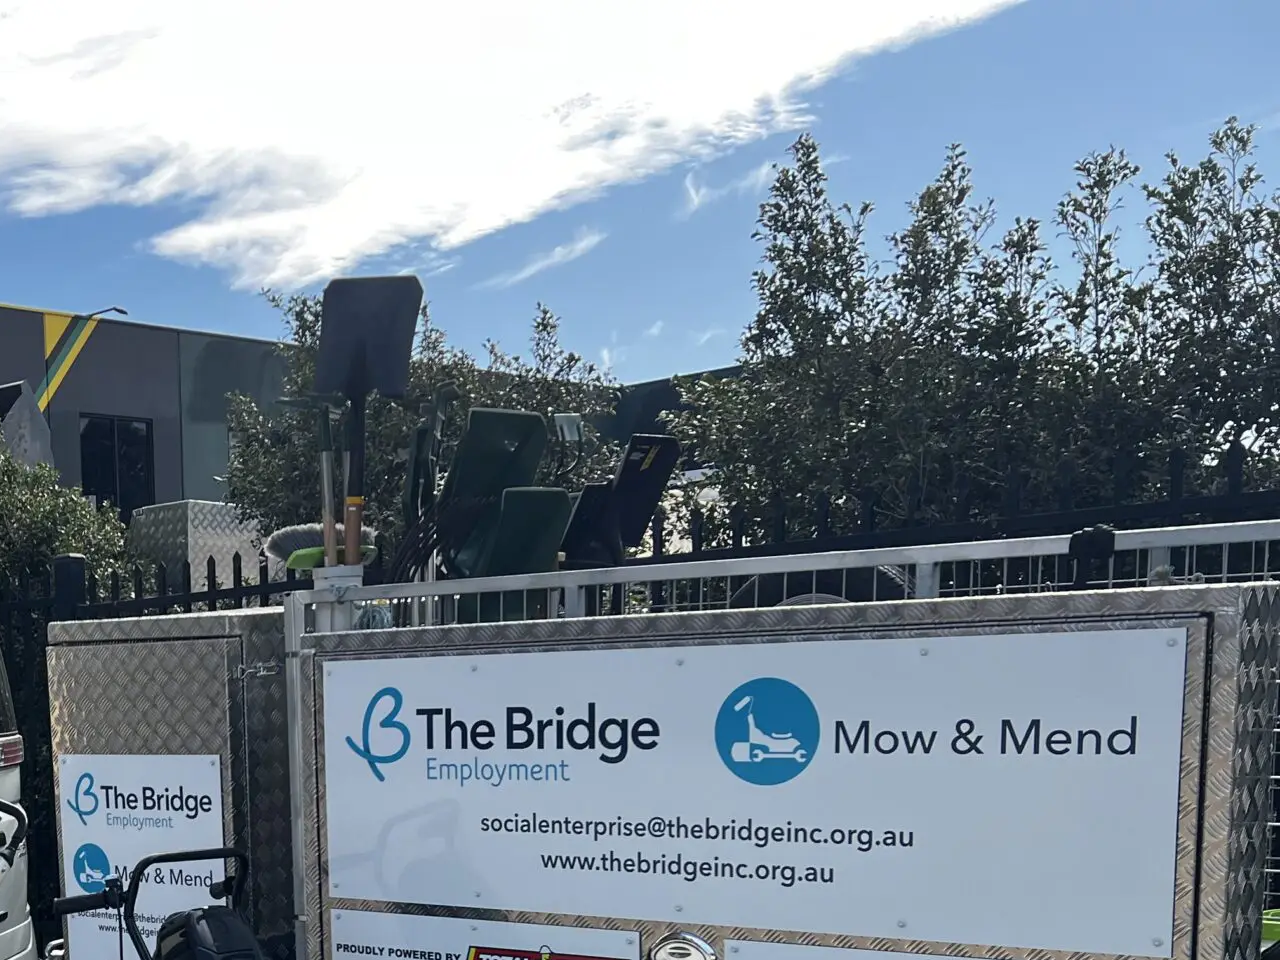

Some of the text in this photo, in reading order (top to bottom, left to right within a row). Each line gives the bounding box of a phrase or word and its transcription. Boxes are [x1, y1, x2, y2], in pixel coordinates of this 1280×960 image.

[416, 702, 660, 764] The Bridge
[834, 715, 1138, 756] Mow & Mend
[426, 756, 571, 787] Employment
[101, 785, 213, 819] The Bridge
[106, 812, 174, 830] Employment
[480, 812, 914, 851] socialenterprise@thebridgeinc.org.au
[154, 867, 166, 885] &
[170, 869, 213, 888] Mend
[541, 851, 835, 888] www.thebridgeinc.org.au
[335, 943, 385, 957] PROUDLY
[388, 947, 442, 960] POWERED
